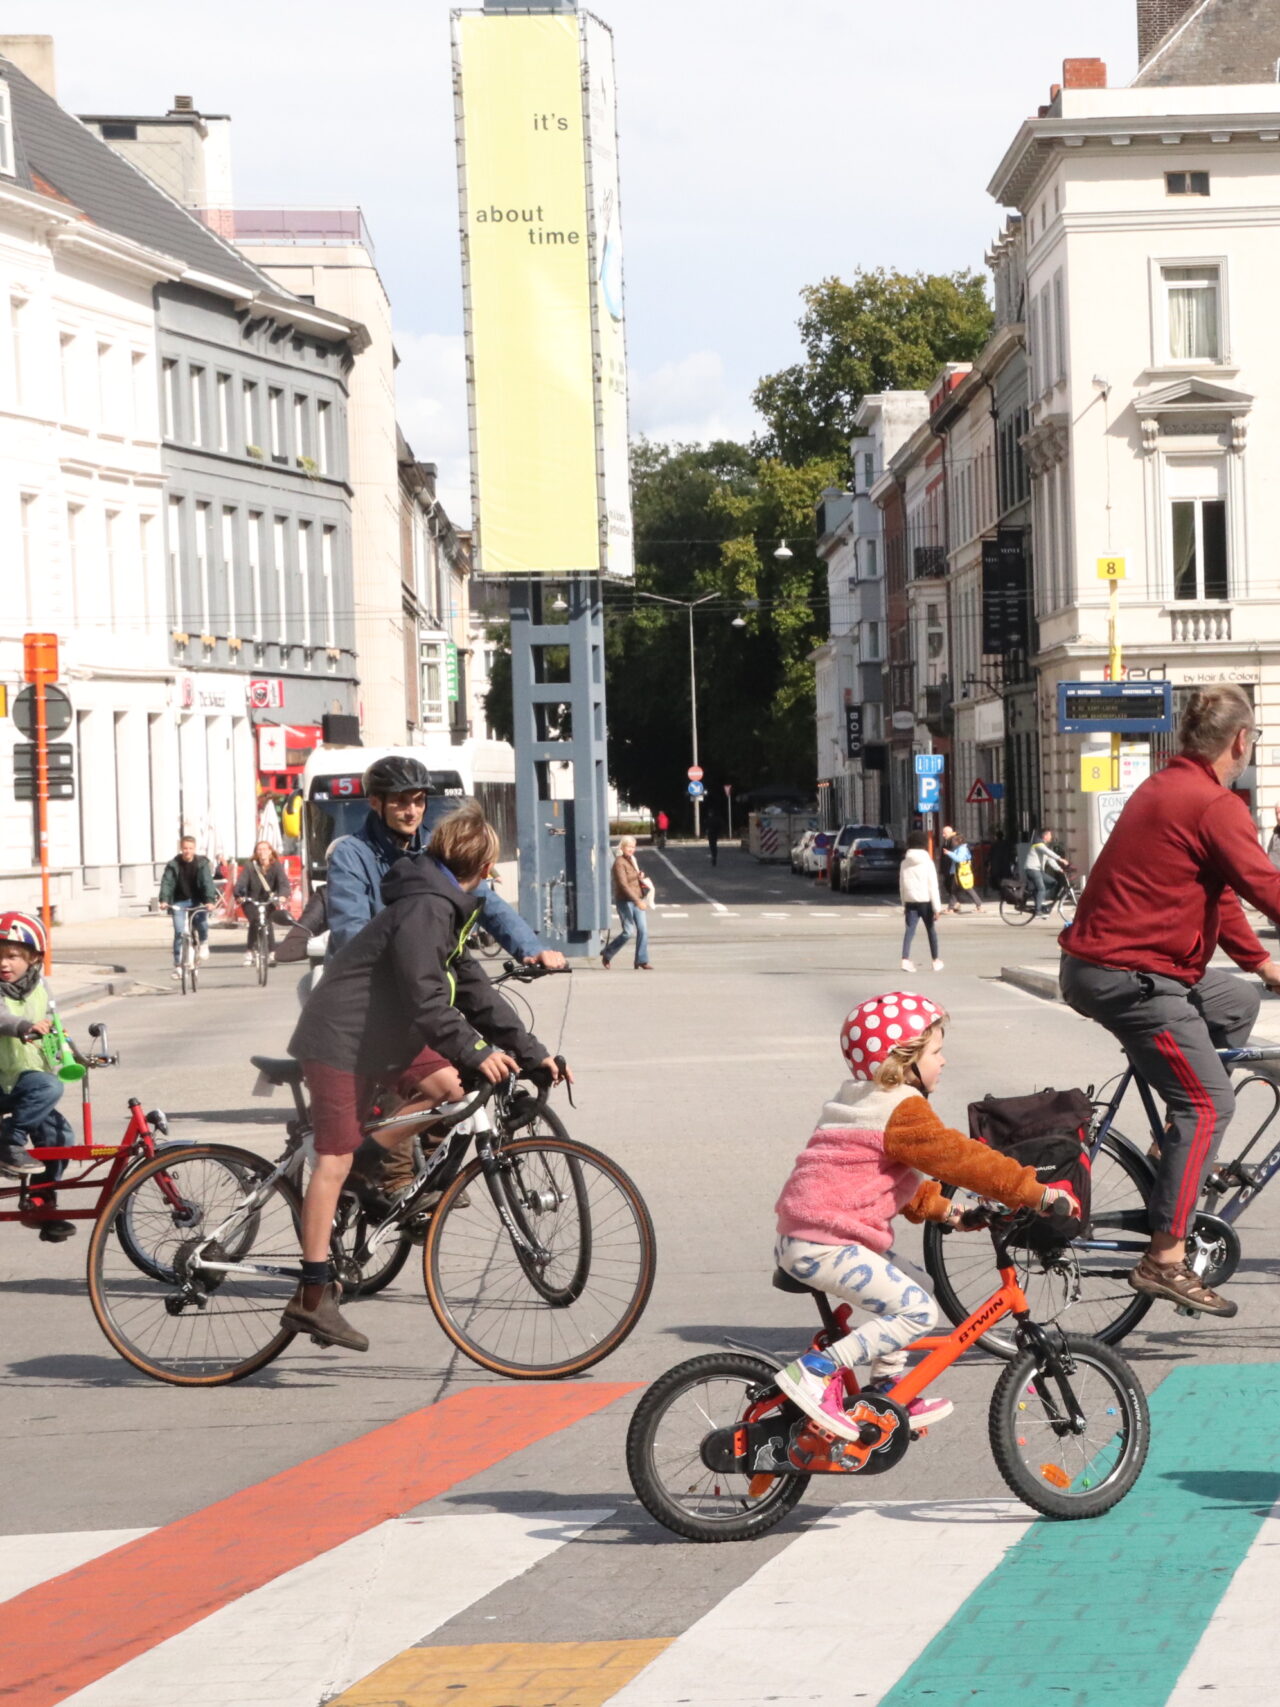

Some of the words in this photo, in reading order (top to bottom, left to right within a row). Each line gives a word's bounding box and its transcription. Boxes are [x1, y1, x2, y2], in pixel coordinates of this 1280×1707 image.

[533, 112, 569, 131] it's
[475, 204, 544, 223] about
[528, 227, 580, 245] time
[1106, 561, 1116, 575] 8
[1183, 674, 1194, 682] by
[1197, 672, 1216, 682] Hair
[1218, 672, 1225, 681] &
[1228, 672, 1259, 681] Colors
[849, 711, 860, 751] BOLD
[1091, 766, 1101, 779] 8
[338, 777, 353, 795] 5
[921, 777, 937, 799] P
